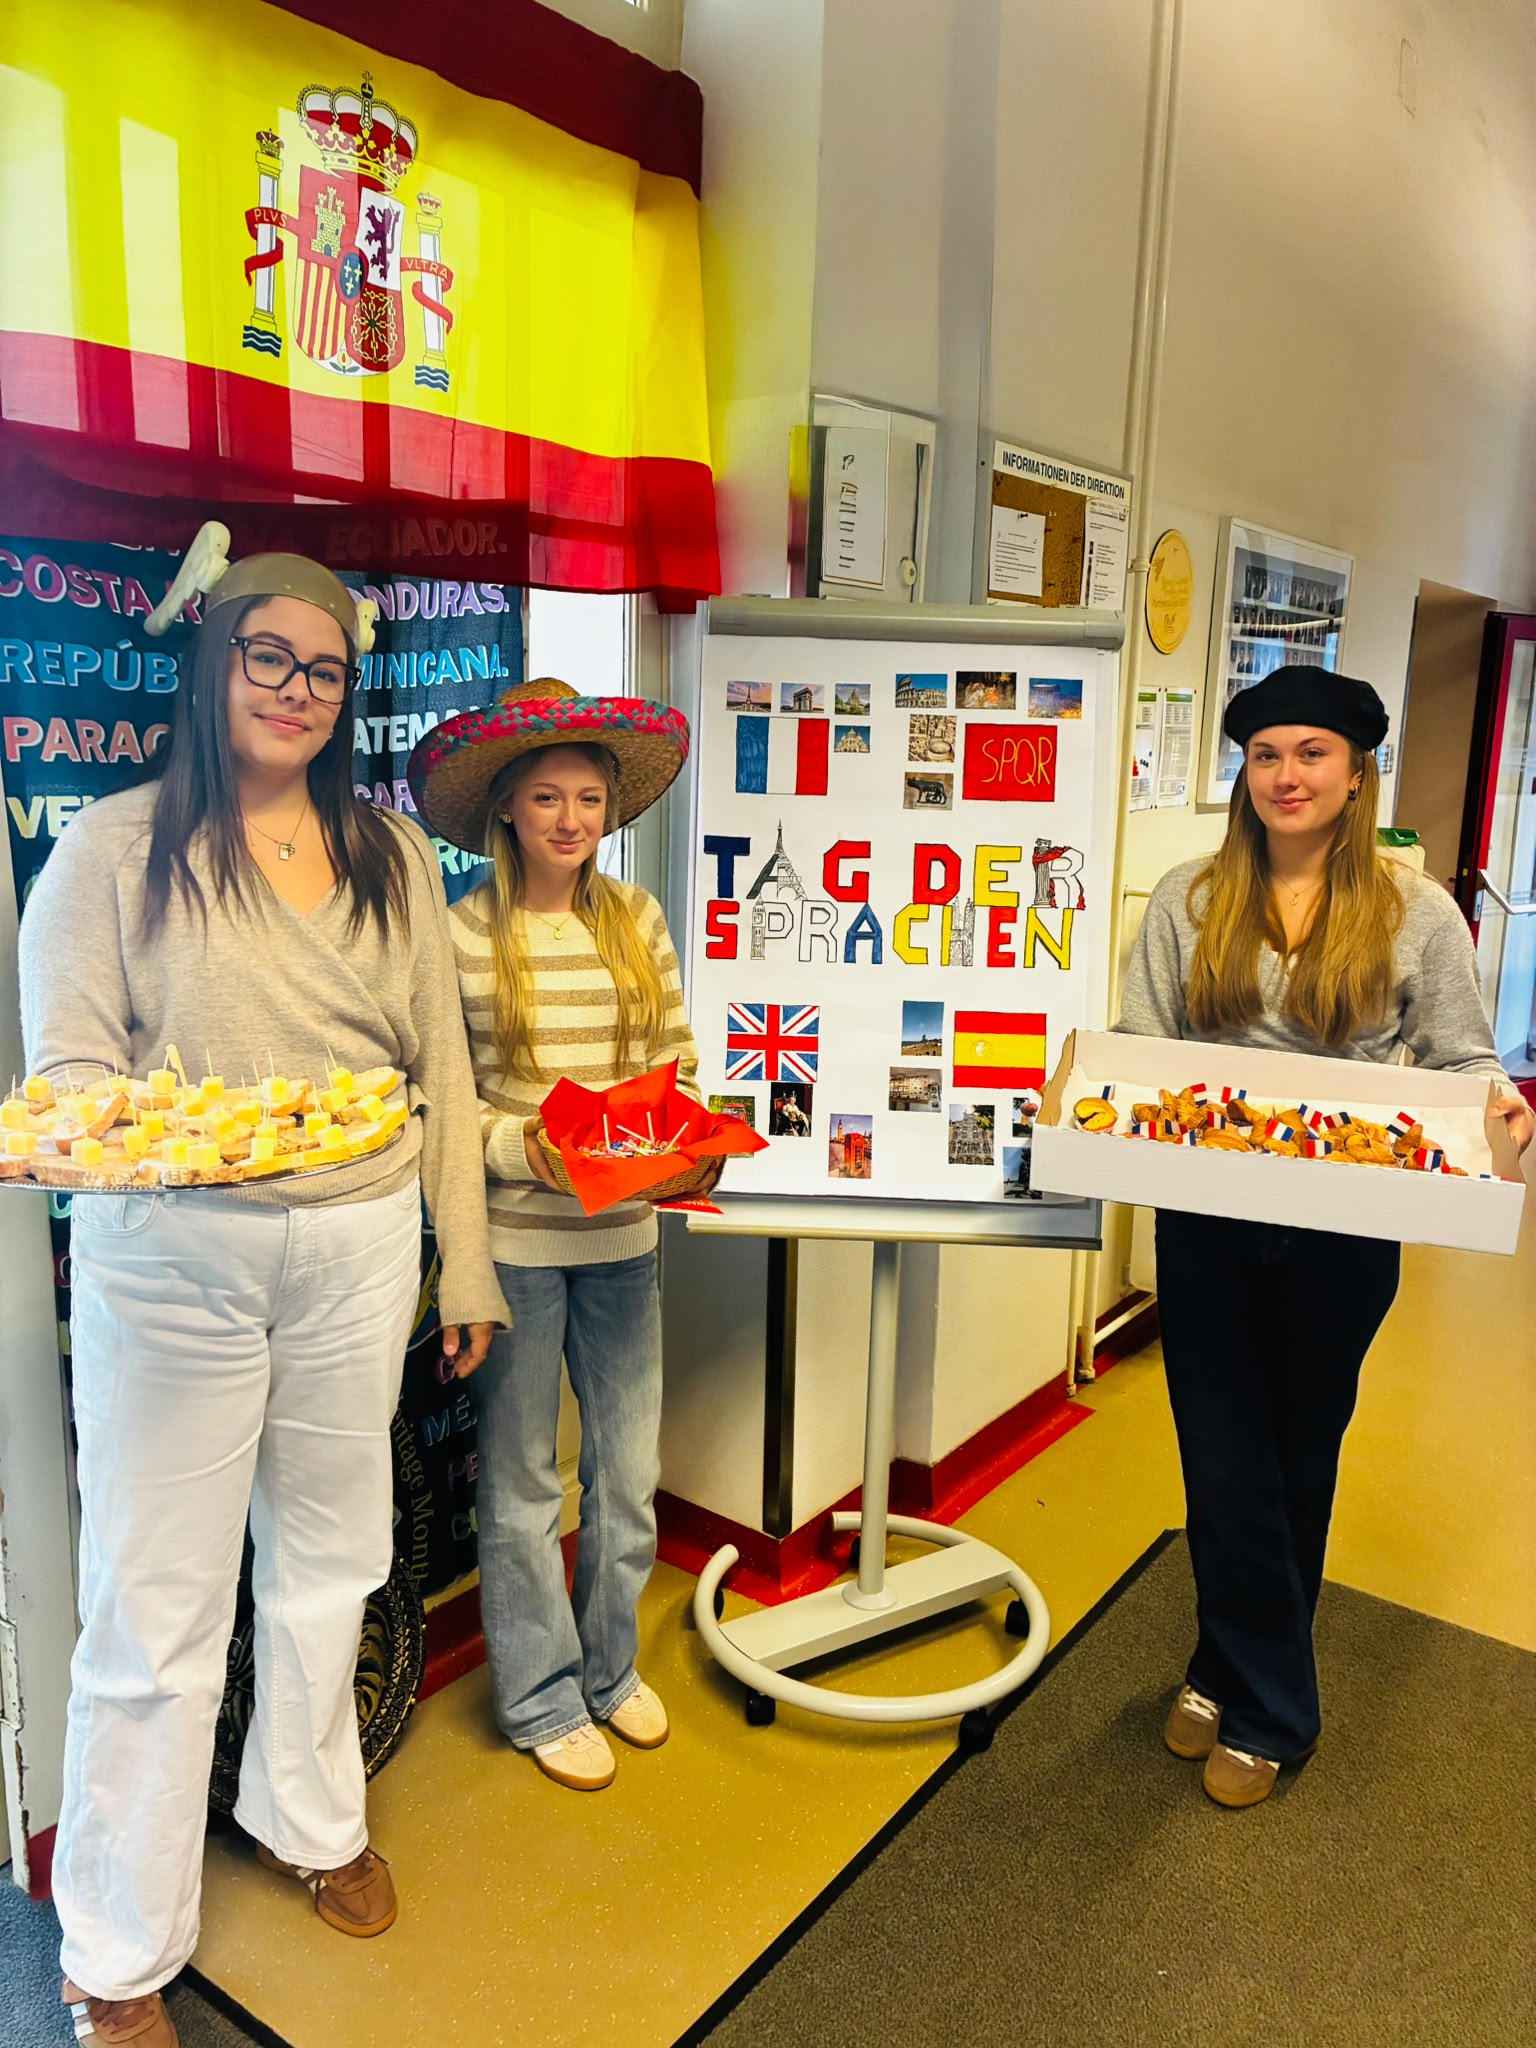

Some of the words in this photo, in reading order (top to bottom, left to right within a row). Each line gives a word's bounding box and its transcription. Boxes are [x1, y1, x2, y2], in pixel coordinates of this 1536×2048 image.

[253, 208, 288, 227] PLVS
[405, 258, 449, 279] VLTRA
[1002, 450, 1069, 483] INFORMATIONEN
[1070, 471, 1086, 488] DER
[1087, 476, 1125, 499] DIREKTION
[0, 548, 154, 618] COSTA
[0, 638, 185, 693] REPÚB
[981, 736, 1054, 787] SPQR
[703, 818, 872, 902] TAG
[912, 838, 1087, 911] DER
[705, 896, 1075, 970] SPRACHEN
